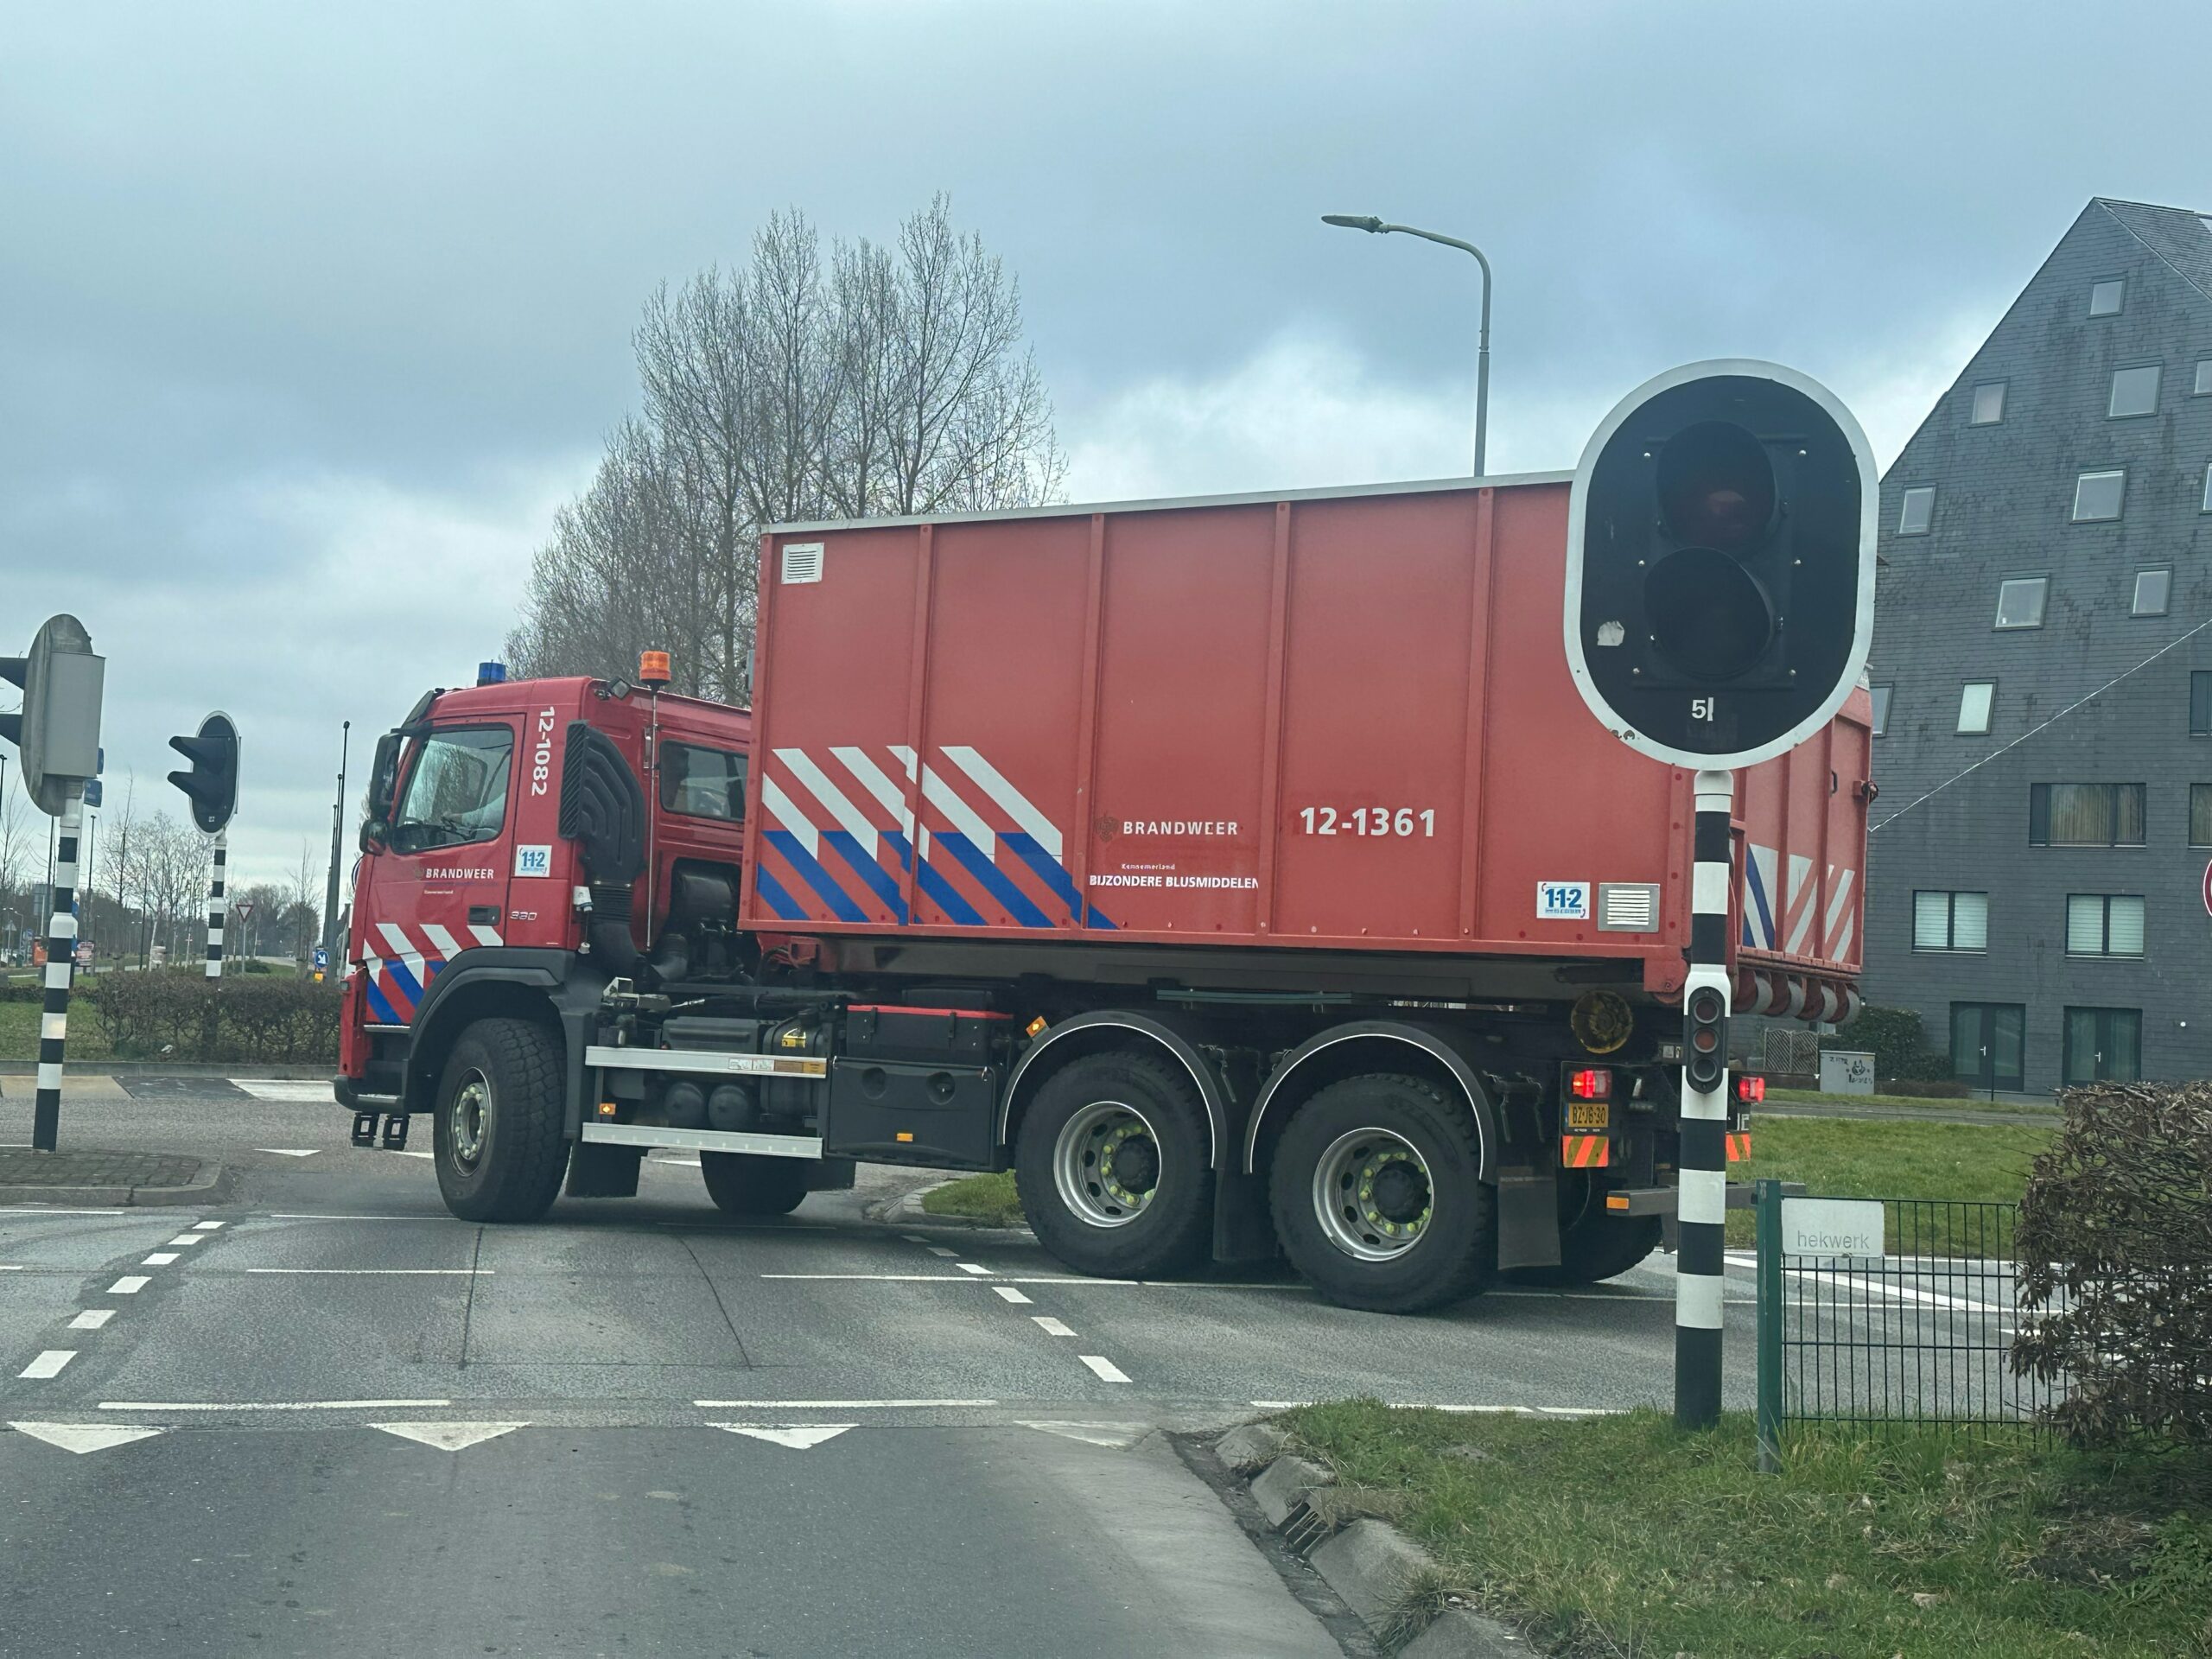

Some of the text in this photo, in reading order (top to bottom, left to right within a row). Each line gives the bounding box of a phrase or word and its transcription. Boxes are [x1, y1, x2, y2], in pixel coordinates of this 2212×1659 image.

[531, 706, 555, 797] 12-1082
[1123, 821, 1238, 836] BRANDWEER
[1300, 807, 1435, 837] 12-1361
[425, 868, 494, 880] BRANDWEER
[1089, 874, 1259, 889] BIJZONDERE BLUSMIDDELEN
[1797, 1230, 1870, 1250] hekwerk
